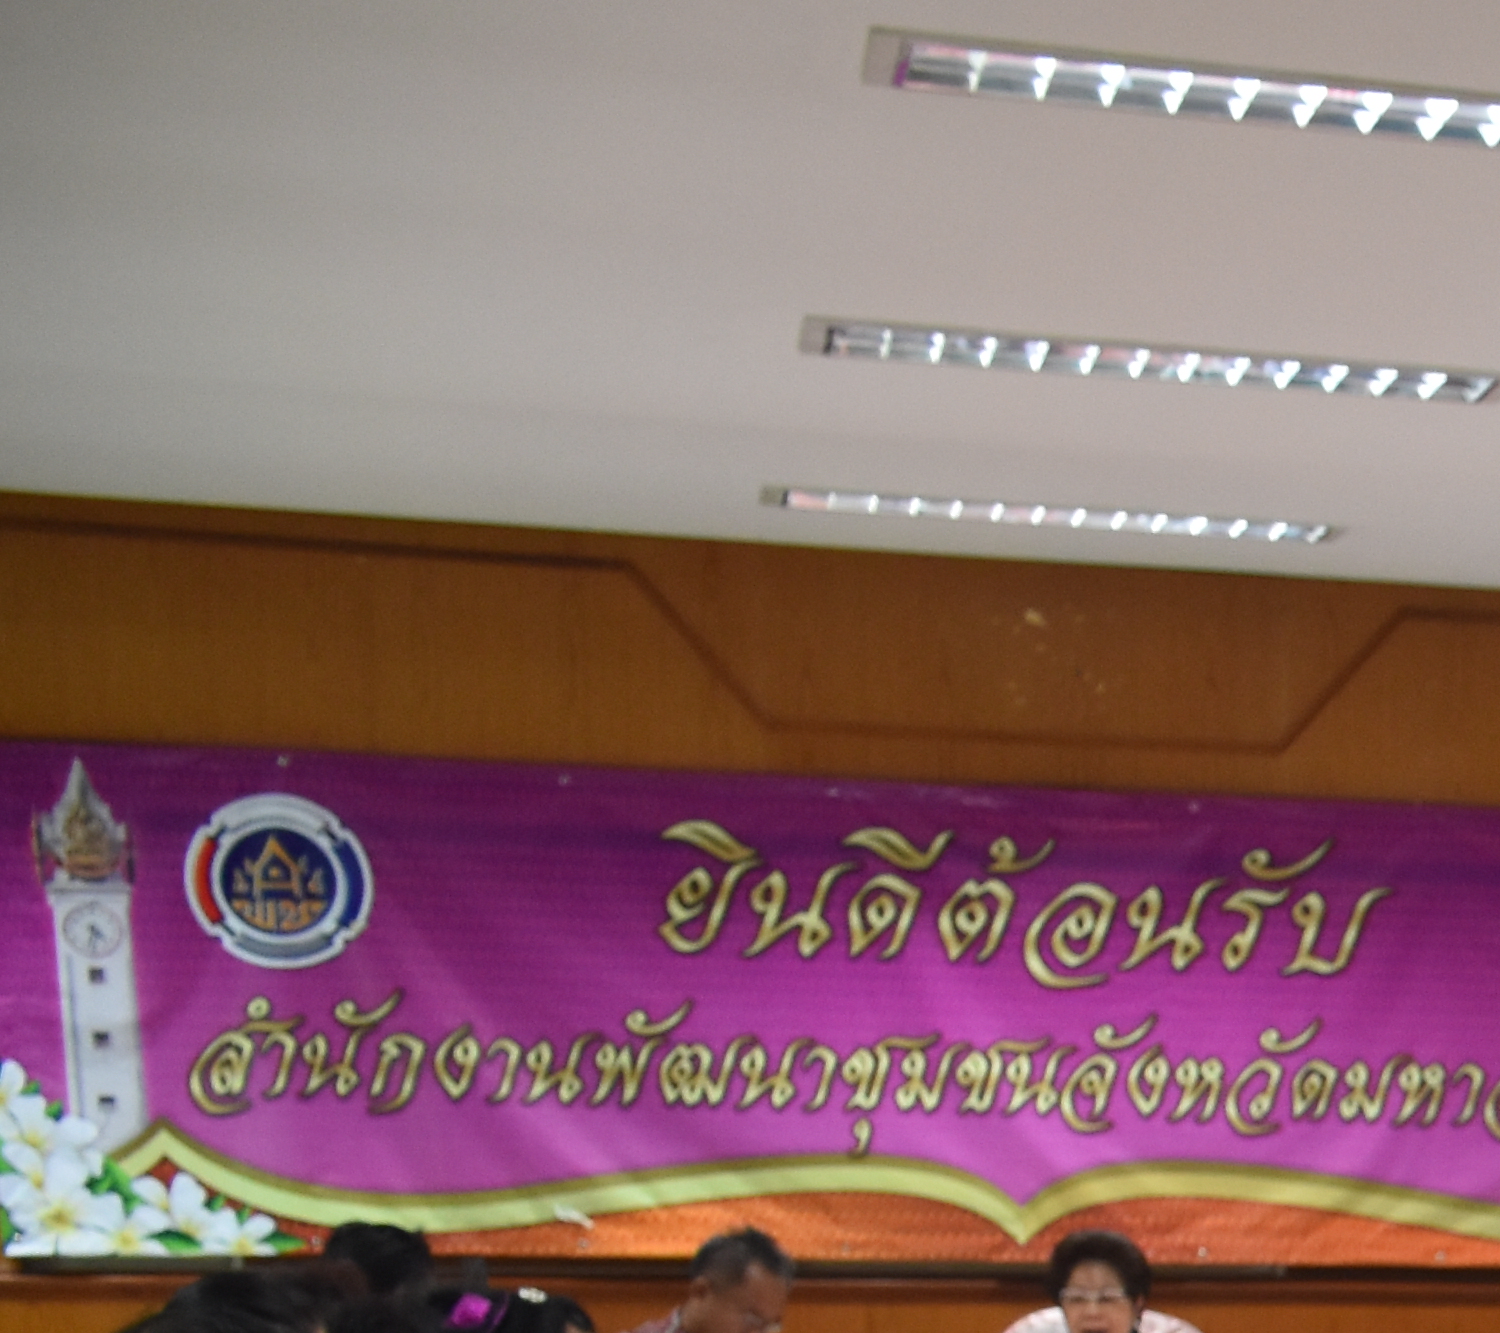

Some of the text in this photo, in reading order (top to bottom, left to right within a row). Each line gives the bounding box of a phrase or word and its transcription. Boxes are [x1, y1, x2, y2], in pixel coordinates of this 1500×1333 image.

[656, 817, 1396, 990] ยินดีต้อนรับ
